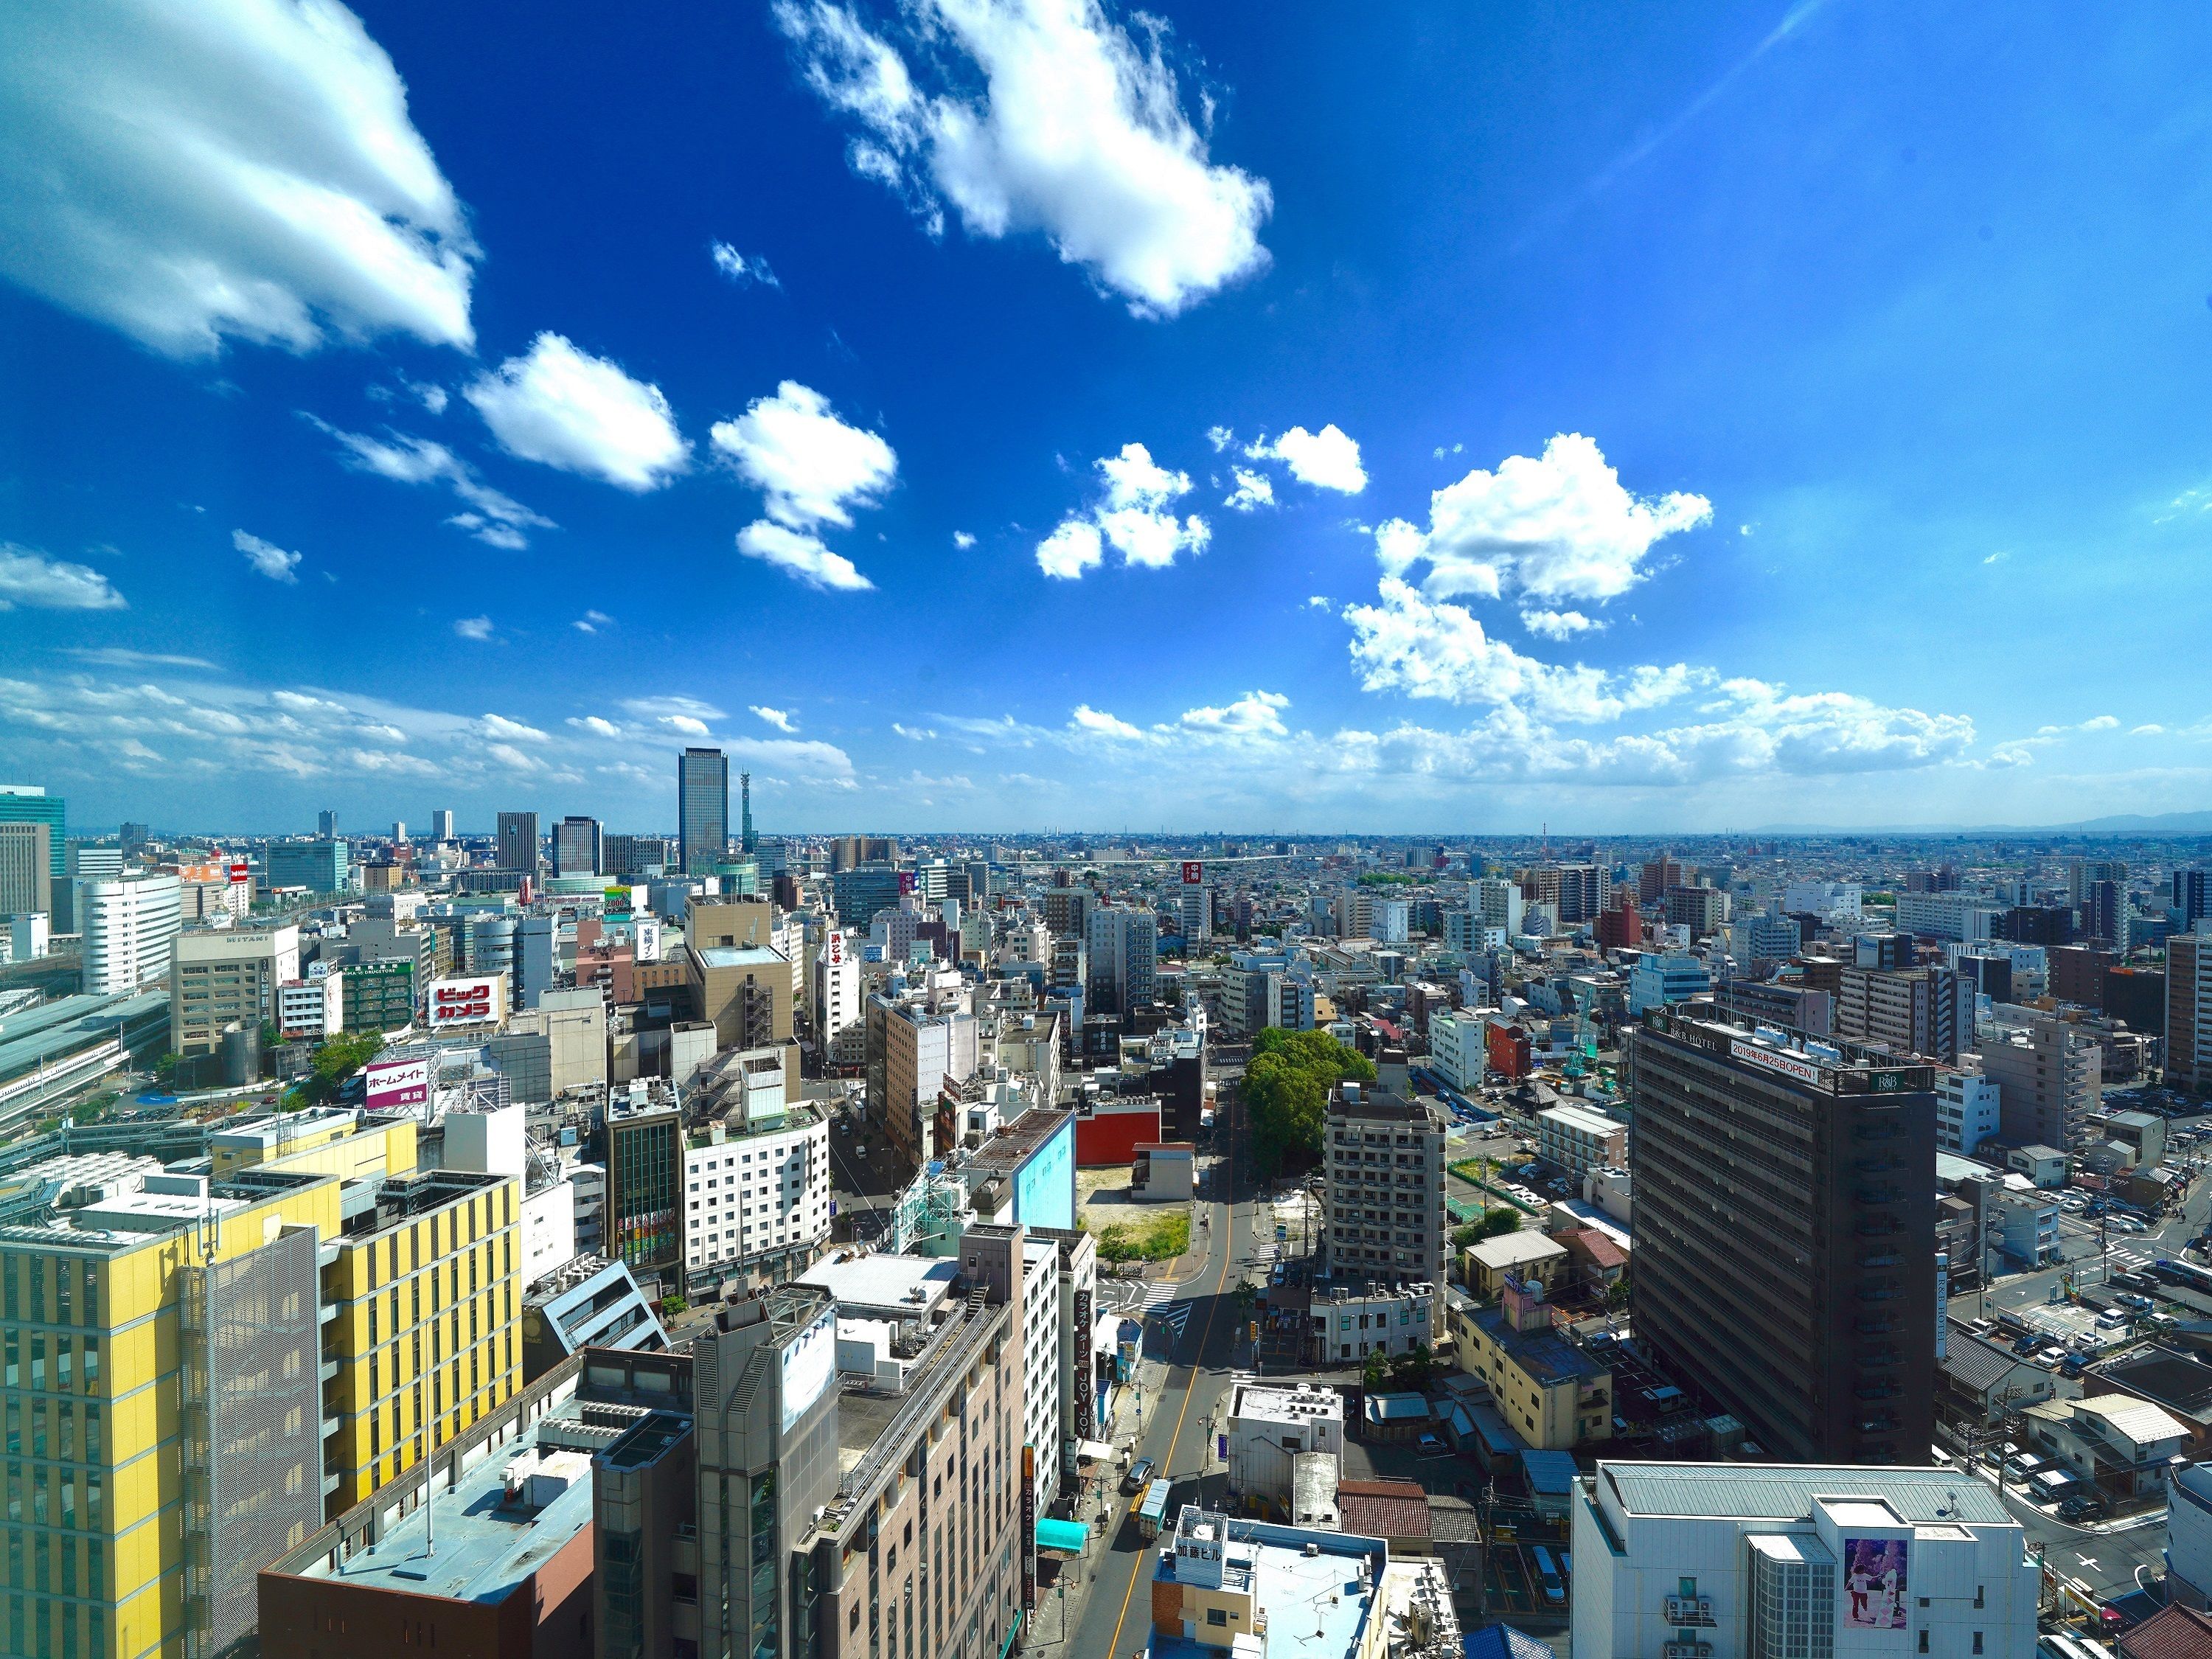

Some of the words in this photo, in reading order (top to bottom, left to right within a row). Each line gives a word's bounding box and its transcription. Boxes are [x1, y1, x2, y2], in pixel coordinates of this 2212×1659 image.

[1192, 864, 1198, 880] 中駒
[644, 928, 654, 959] 東横イン
[831, 933, 842, 964] 浜乙女
[438, 986, 490, 1001] ビック
[438, 1003, 490, 1018] カメラ
[1671, 1027, 1686, 1041] R&B
[1689, 1034, 1717, 1051] HOTEL
[369, 1071, 425, 1089] ホームメイト
[1879, 1076, 1897, 1088] R&B
[400, 1090, 424, 1101] 賃貸
[1079, 1293, 1088, 1328] カラオケ
[1079, 1333, 1088, 1358] ダーツ
[1079, 1373, 1088, 1402] JOY
[1079, 1407, 1088, 1437] JOY
[1177, 1544, 1222, 1562] 加藤ビル
